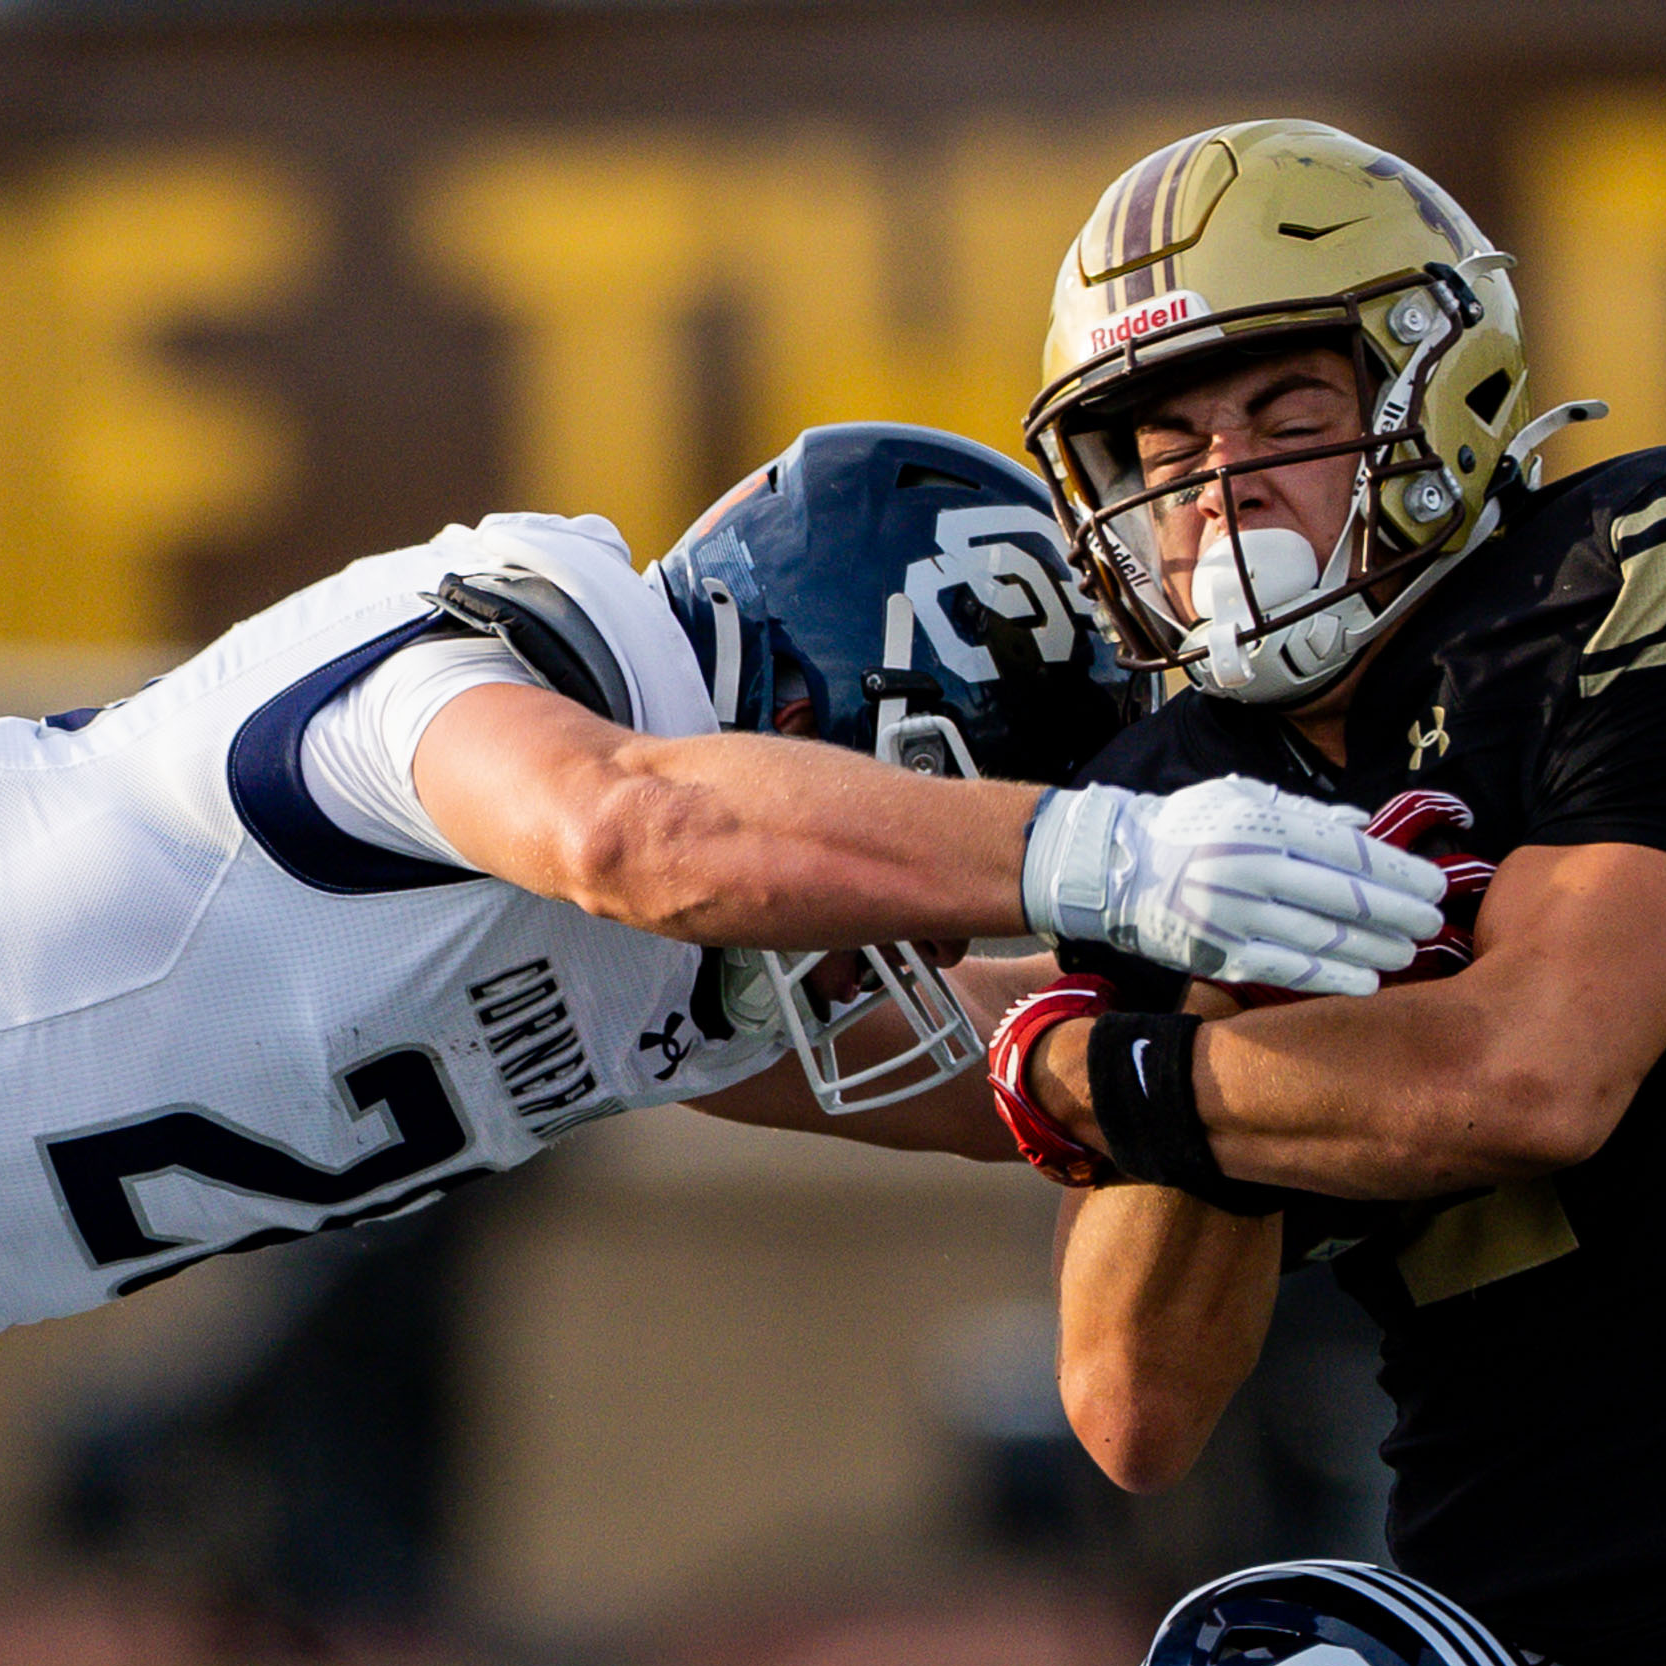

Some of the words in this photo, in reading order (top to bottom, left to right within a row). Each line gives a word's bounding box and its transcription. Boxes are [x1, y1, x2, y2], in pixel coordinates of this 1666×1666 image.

[418, 120, 1133, 580] TH
[1090, 297, 1188, 355] Riddell
[37, 1042, 496, 1298] 2
